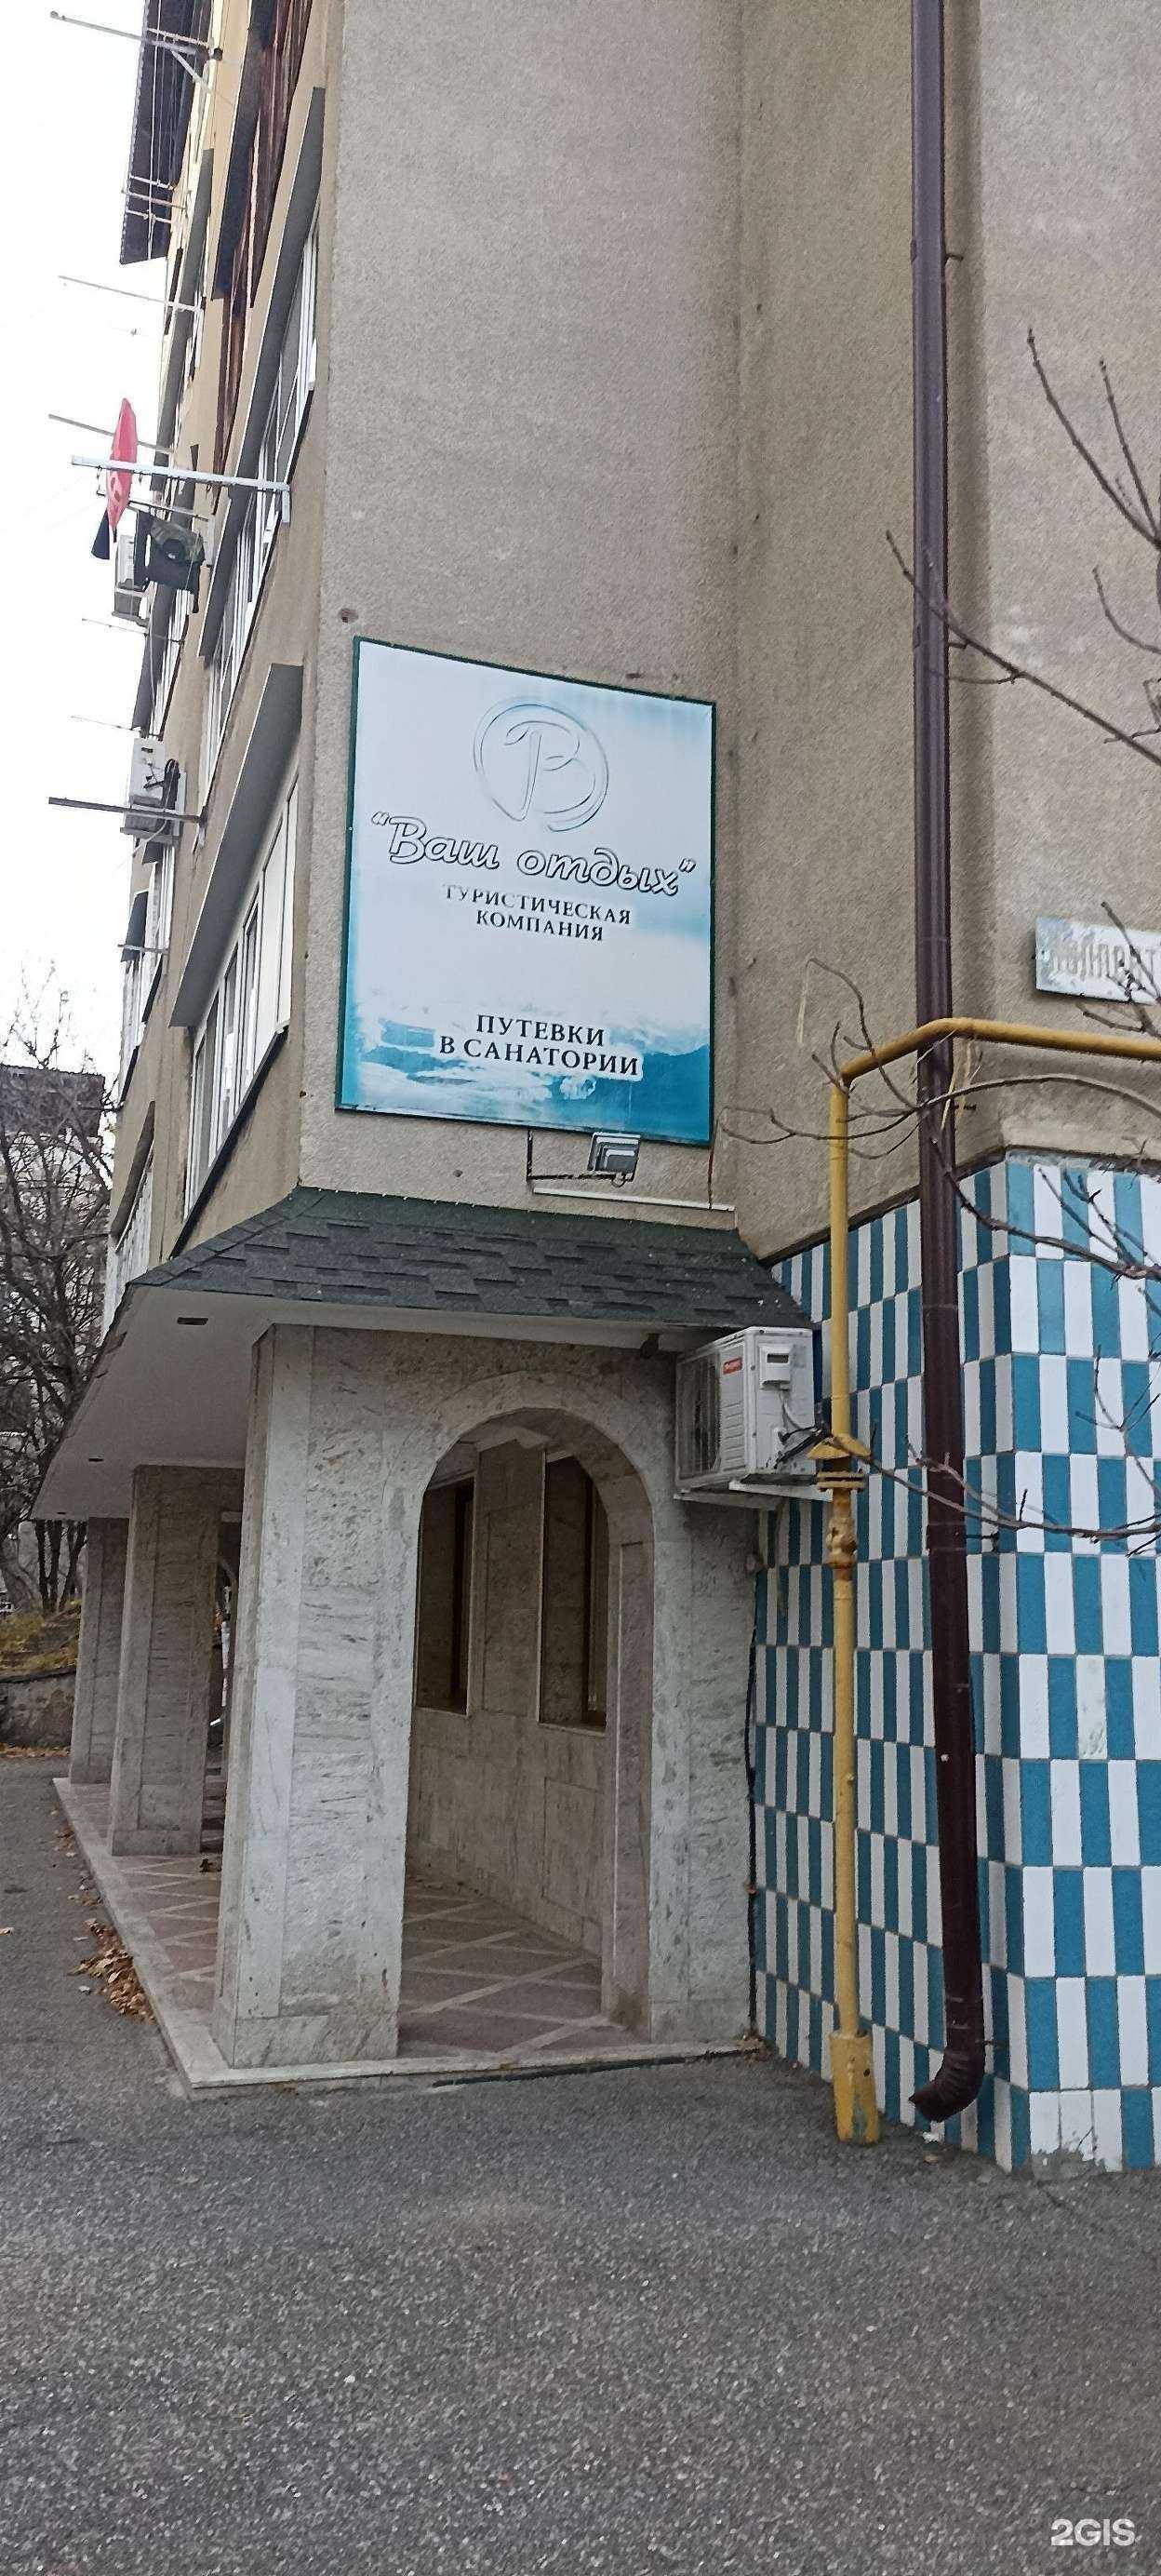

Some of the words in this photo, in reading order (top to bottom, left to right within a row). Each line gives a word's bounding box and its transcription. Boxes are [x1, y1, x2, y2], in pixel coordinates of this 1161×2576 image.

[443, 884, 632, 924] ТУРИСТИЧЕСКАЯ
[476, 909, 604, 942] КОМПАНИЯ
[476, 1013, 605, 1047] ПУТЕВКИ
[439, 1035, 455, 1054] В
[463, 1039, 638, 1076] САНАТОРИИ
